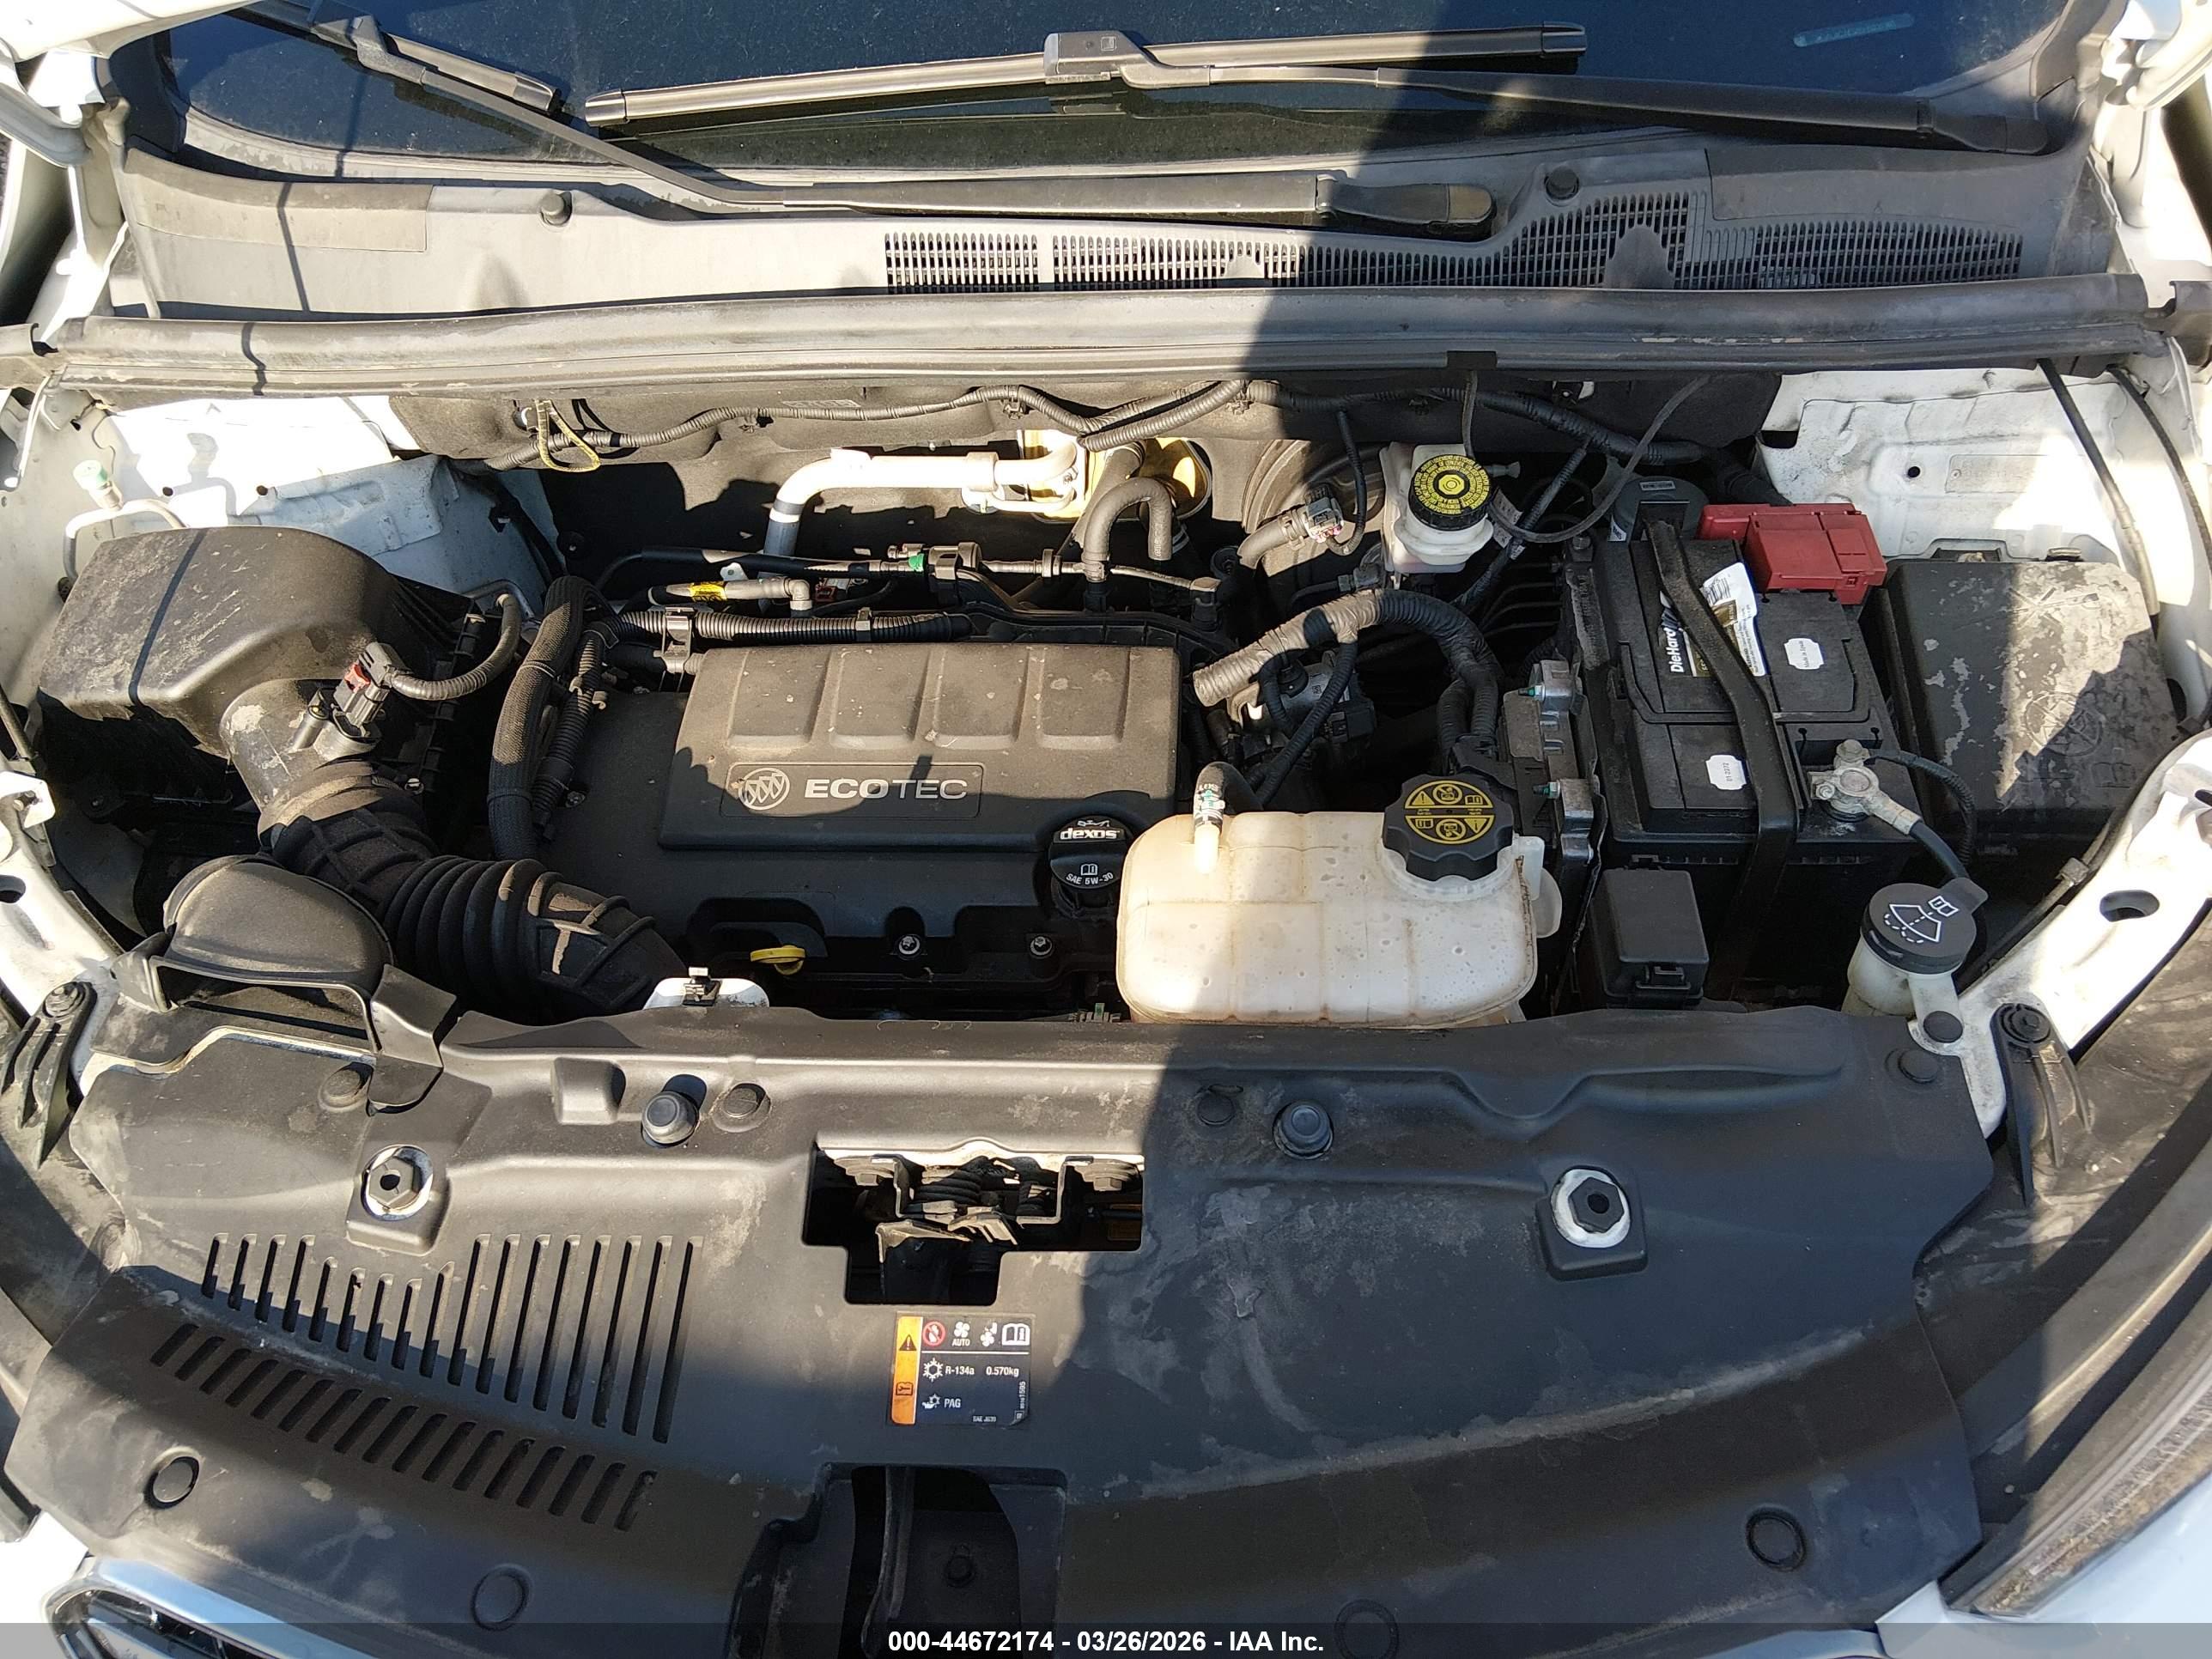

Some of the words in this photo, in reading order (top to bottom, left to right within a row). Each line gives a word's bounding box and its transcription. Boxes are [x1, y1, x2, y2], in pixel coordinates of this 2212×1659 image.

[1663, 627, 1685, 673] DieHard
[805, 778, 968, 799] ECOTEC
[1060, 828, 1118, 840] dexos
[1066, 872, 1082, 884] SAE
[945, 1366, 975, 1376] R-134a
[986, 1366, 1019, 1377] 0.570kg
[944, 1399, 962, 1408] PAG
